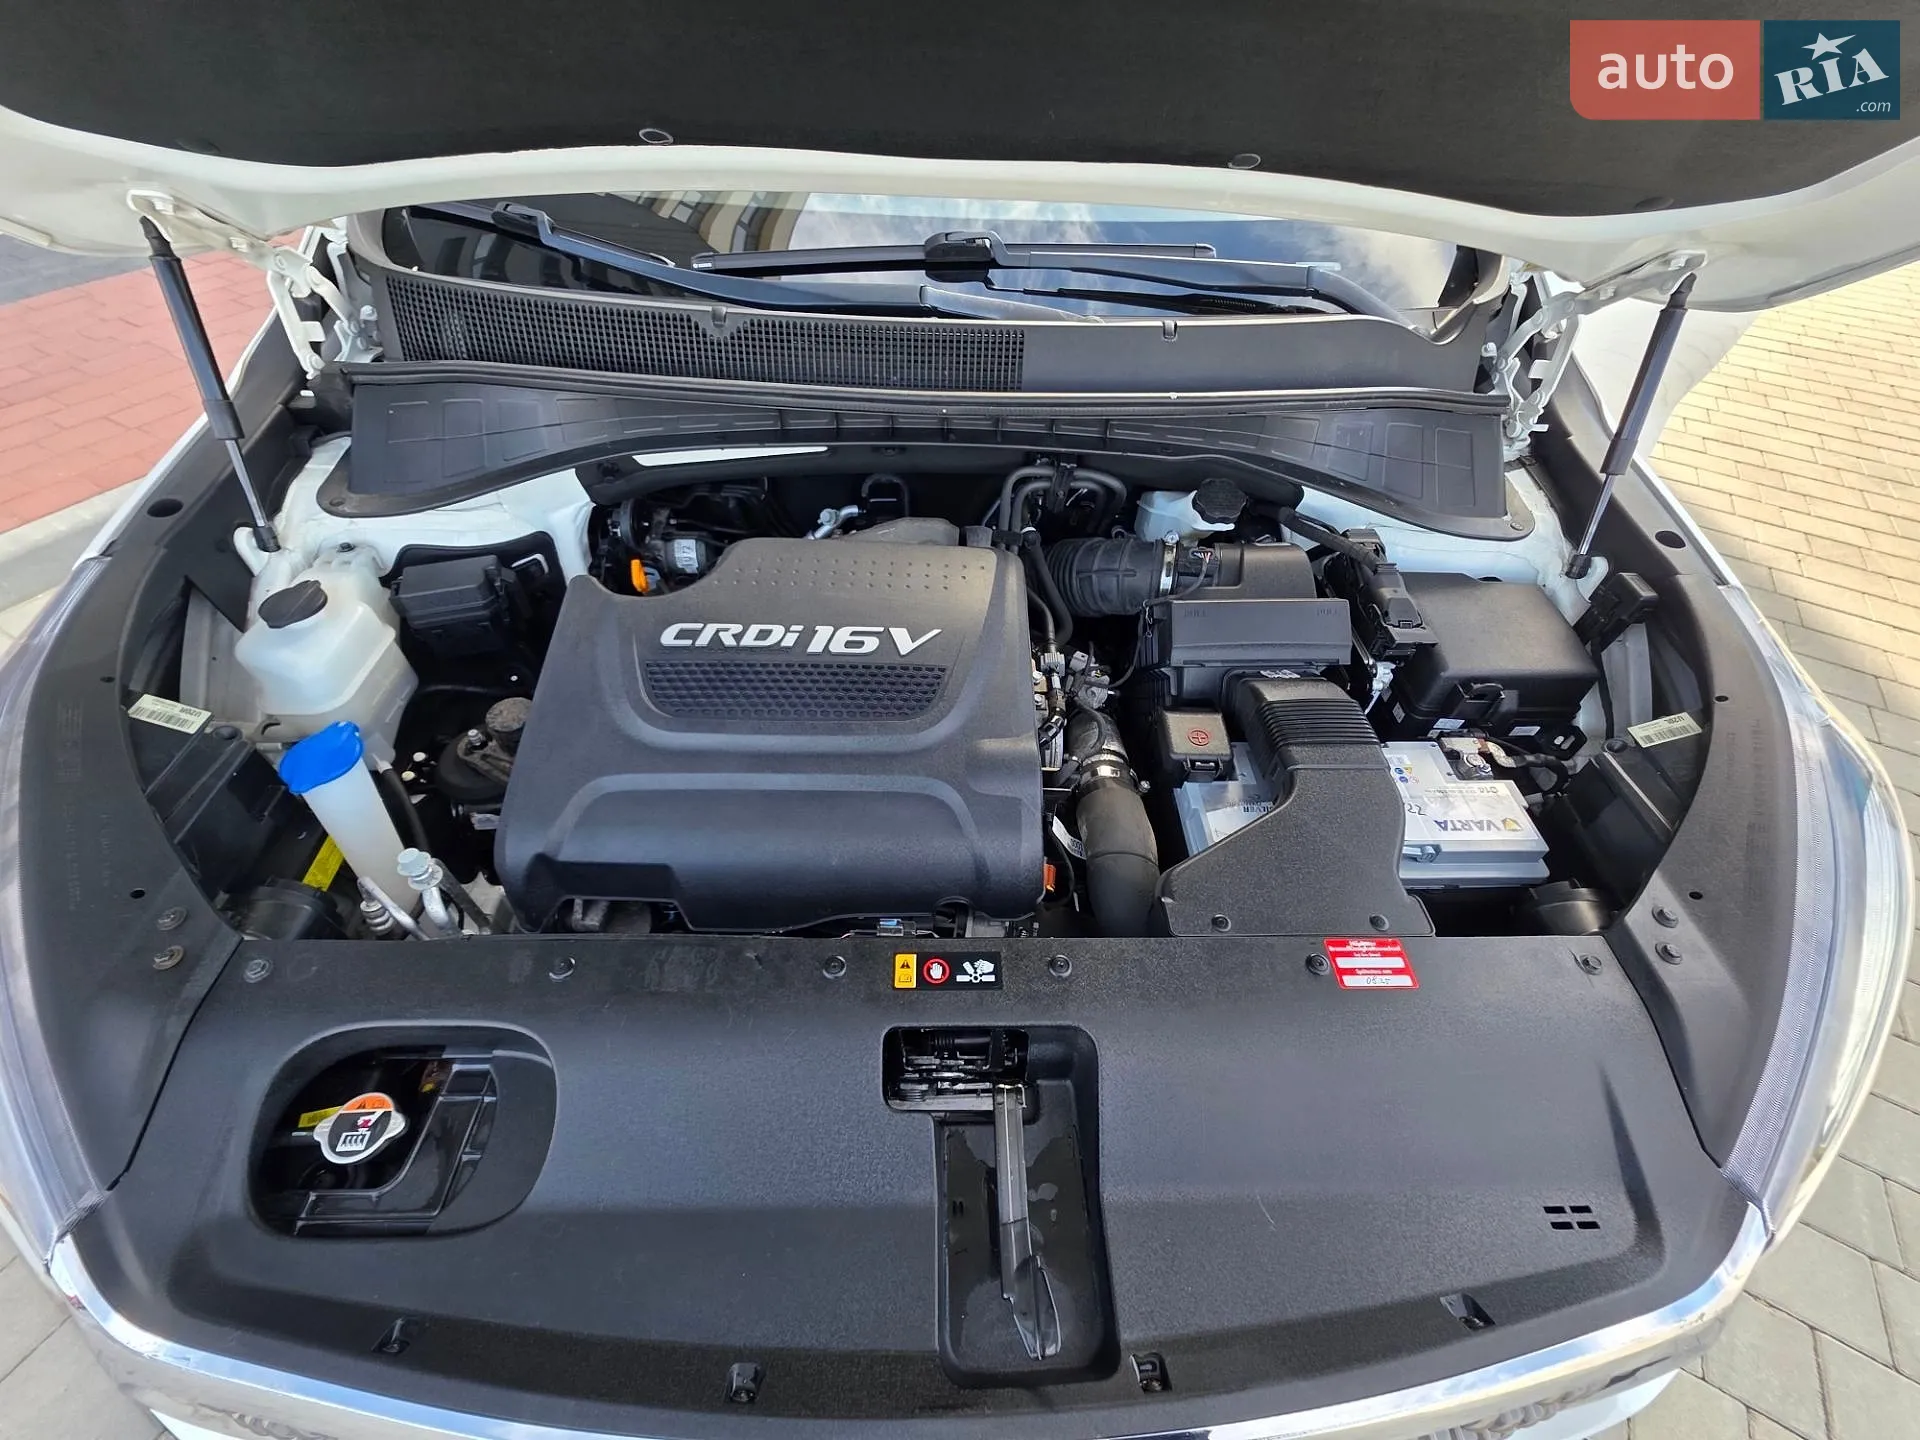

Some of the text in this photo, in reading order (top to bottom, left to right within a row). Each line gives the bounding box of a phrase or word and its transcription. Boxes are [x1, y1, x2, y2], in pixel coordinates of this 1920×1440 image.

[659, 622, 943, 657] CRDi 16V
[1433, 819, 1502, 832] VARTA
